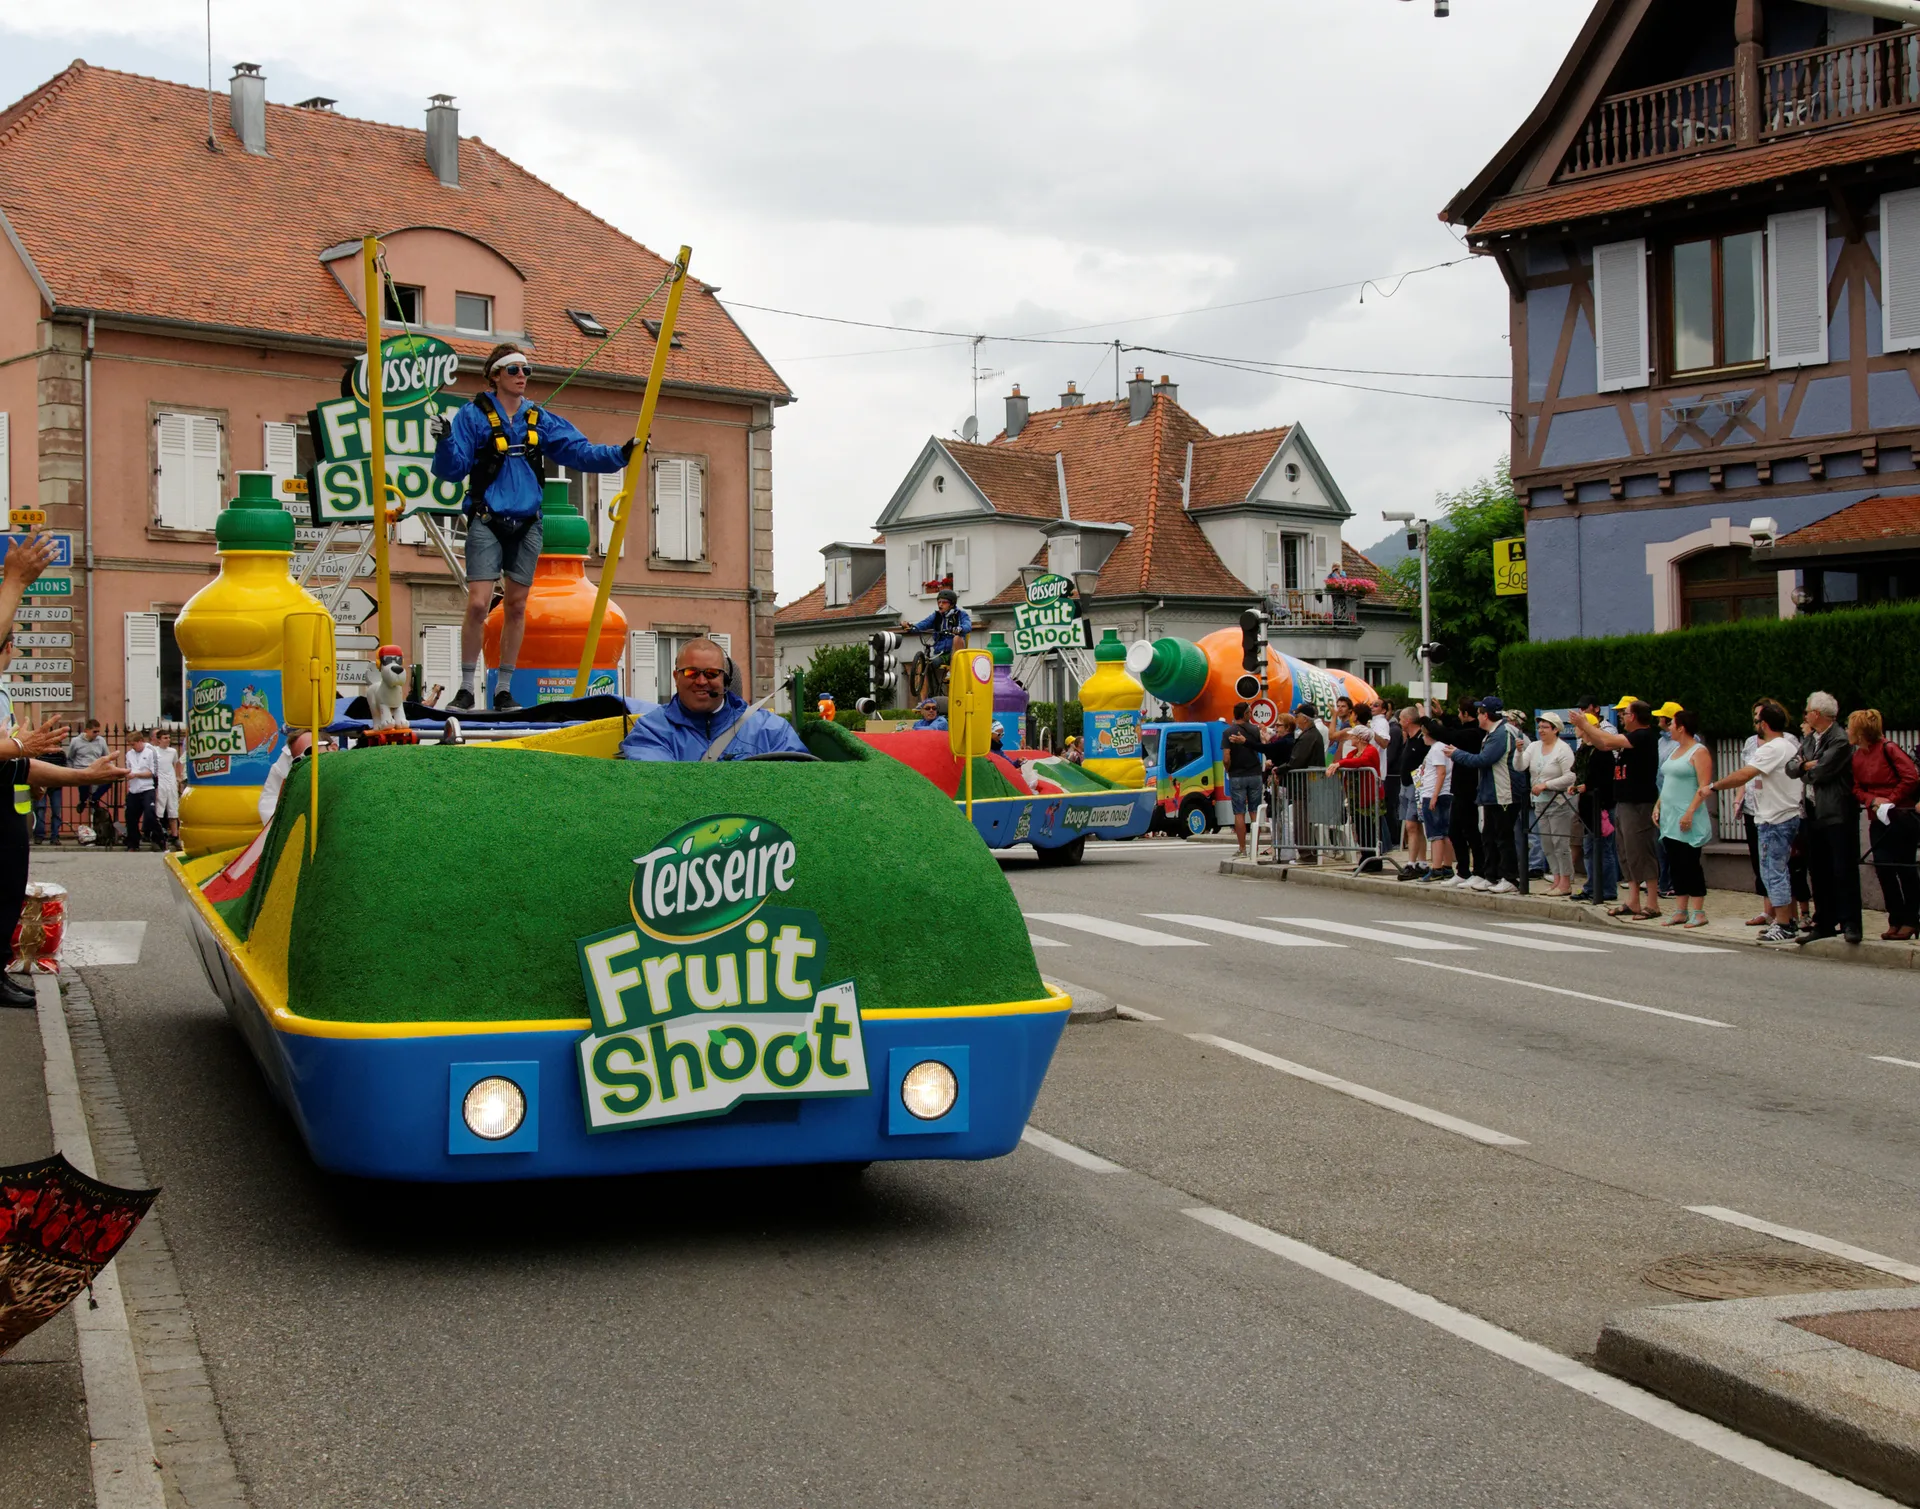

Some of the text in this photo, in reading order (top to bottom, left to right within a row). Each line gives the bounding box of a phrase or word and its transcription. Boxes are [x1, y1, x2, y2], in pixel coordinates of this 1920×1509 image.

[354, 343, 459, 395] Tisseire
[324, 459, 469, 512] Shoo
[12, 513, 43, 521] D 483
[25, 581, 67, 592] CTIONS
[1027, 577, 1068, 602] Teisseire
[1497, 563, 1527, 590] Log
[17, 610, 69, 619] TIER SUD
[1015, 601, 1073, 629] Fruit
[29, 636, 69, 645] S.N.C.F.
[1016, 624, 1081, 650] Shoot
[16, 662, 68, 670] LA POSTE
[8, 687, 72, 697] OURISTIQUE
[193, 682, 227, 706] Teisseire
[188, 707, 233, 734] Fruit
[189, 730, 242, 757] Shoot
[1064, 807, 1089, 829] Bouge
[1091, 810, 1109, 823] avec
[632, 825, 796, 919] Teisseire
[584, 919, 817, 1028] Fruit
[590, 1003, 852, 1116] Shoot
